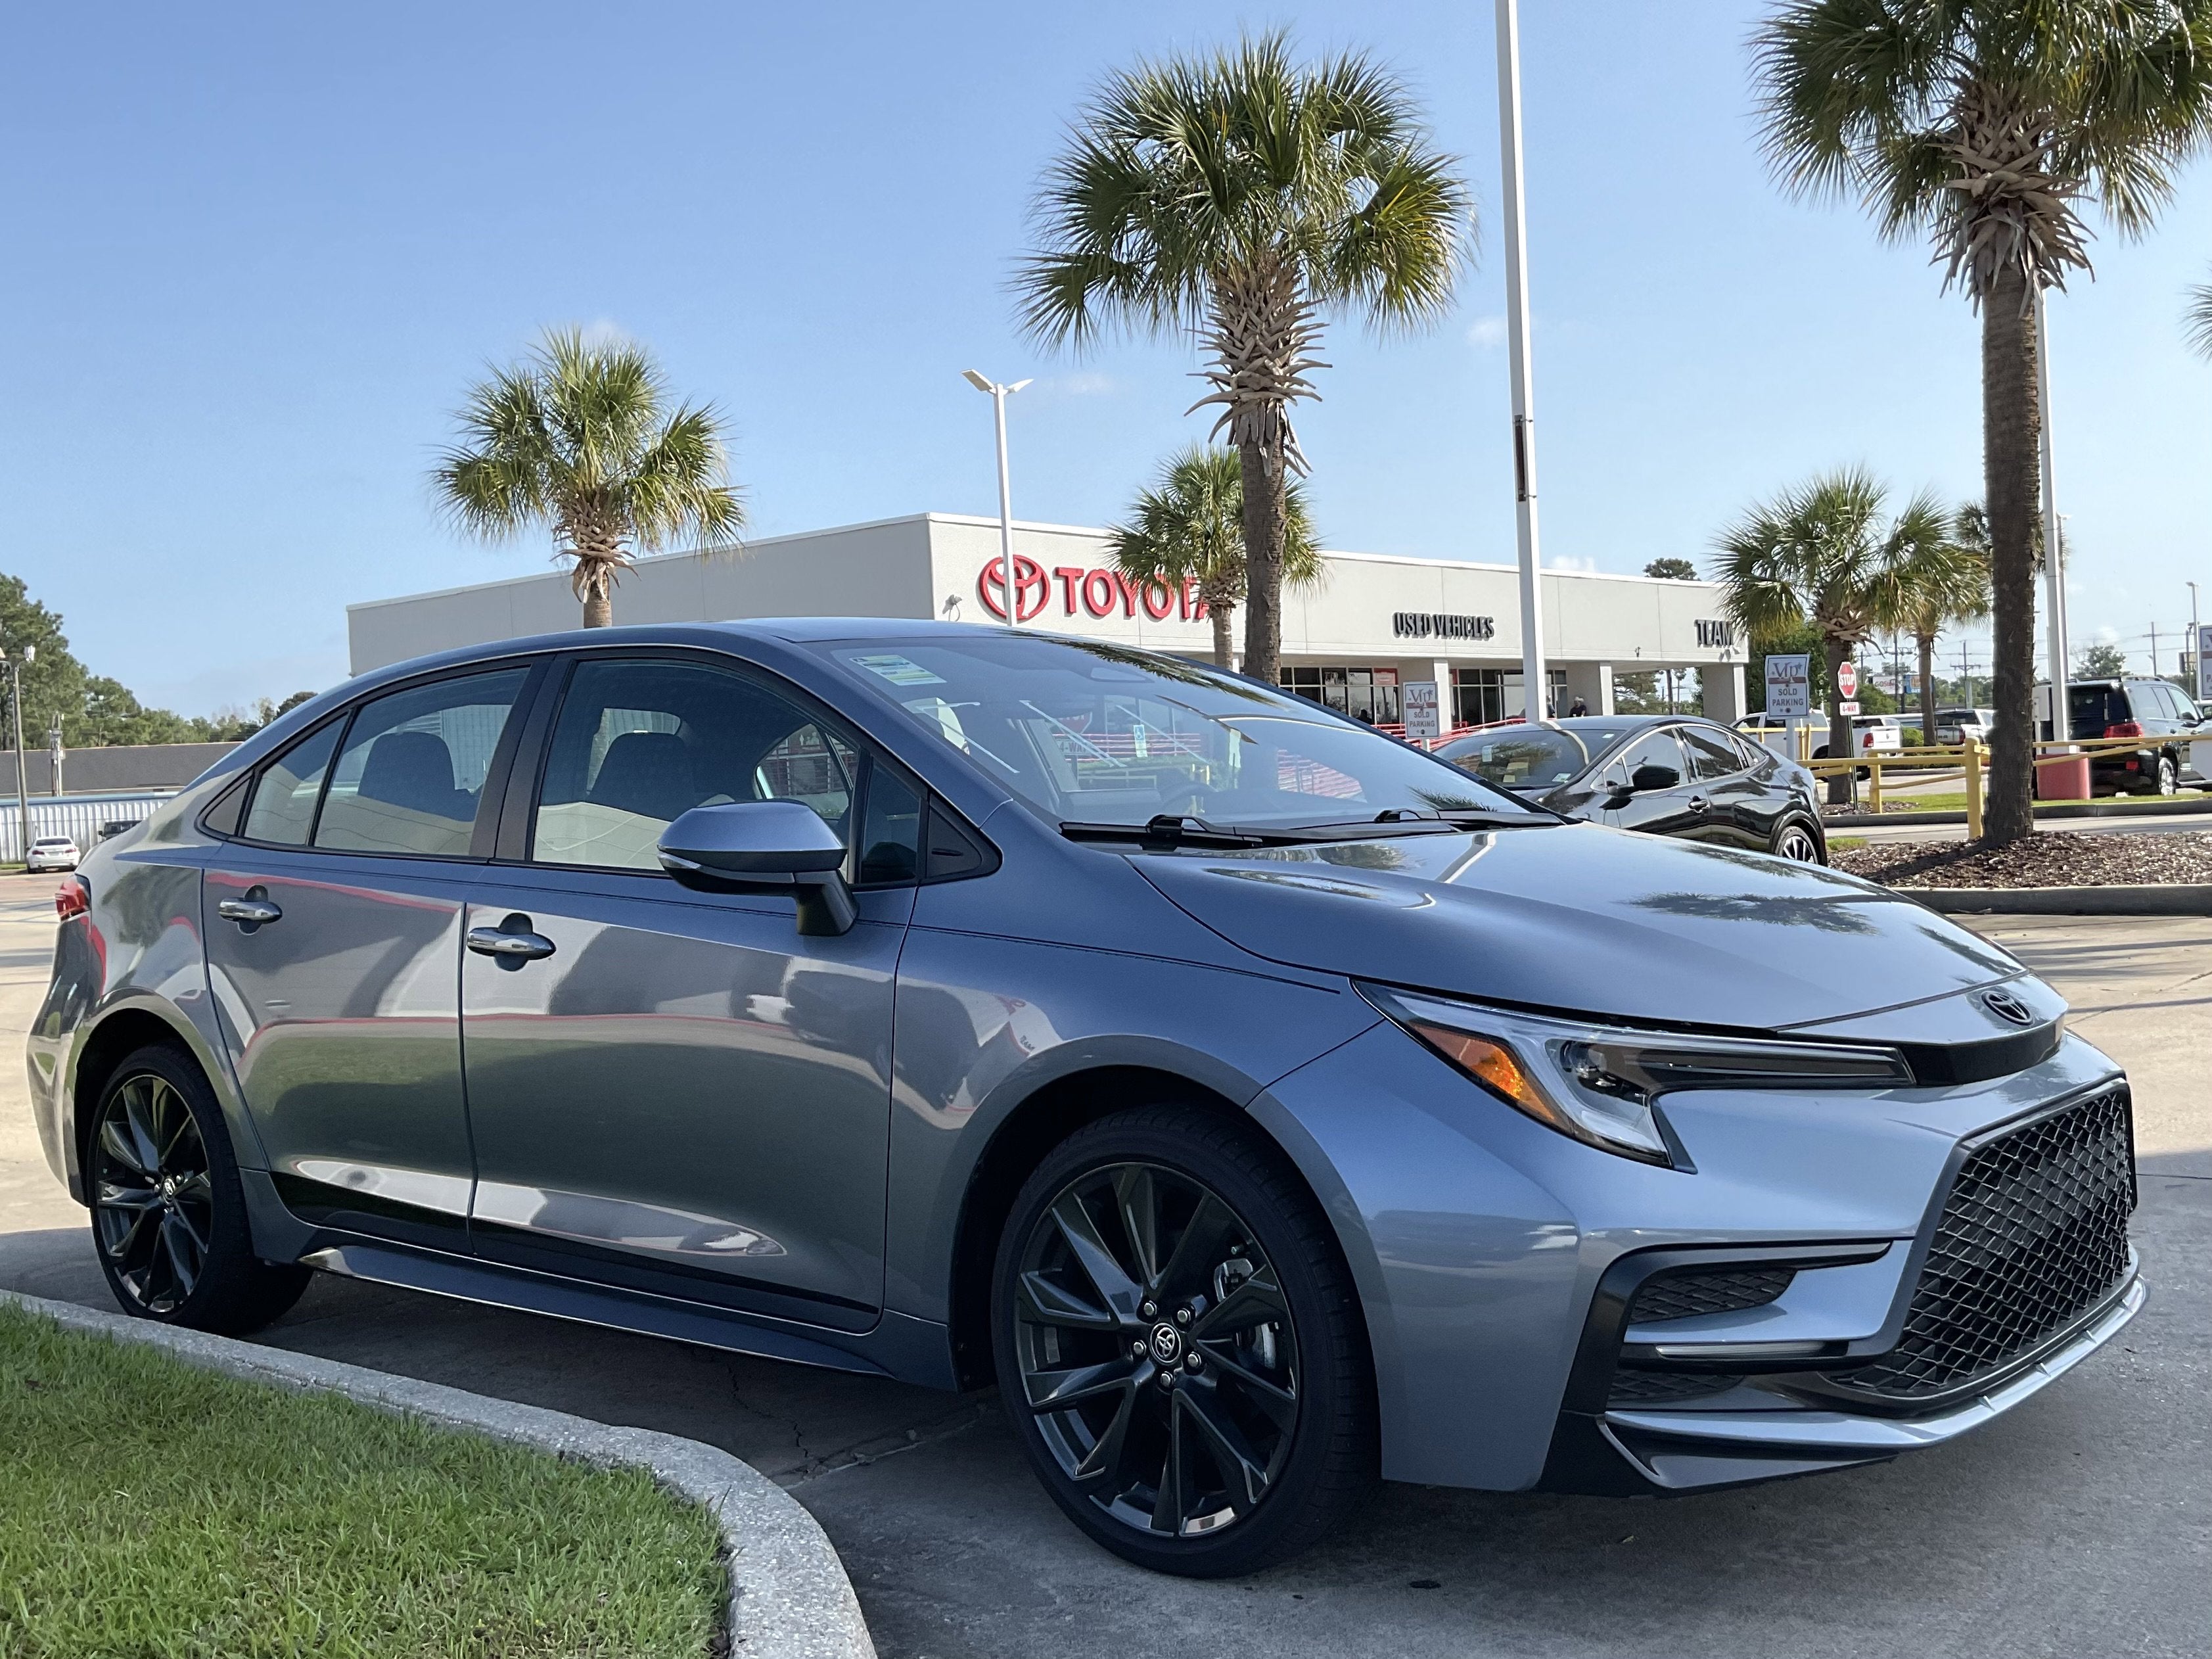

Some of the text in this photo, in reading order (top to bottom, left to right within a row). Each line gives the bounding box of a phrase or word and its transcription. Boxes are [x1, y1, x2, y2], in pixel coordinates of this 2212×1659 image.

[1393, 612, 1494, 640] USED VEHICLES
[1695, 619, 1734, 646] TEAM
[1840, 674, 1855, 686] STOP
[1842, 704, 1856, 713] 4-WAY
